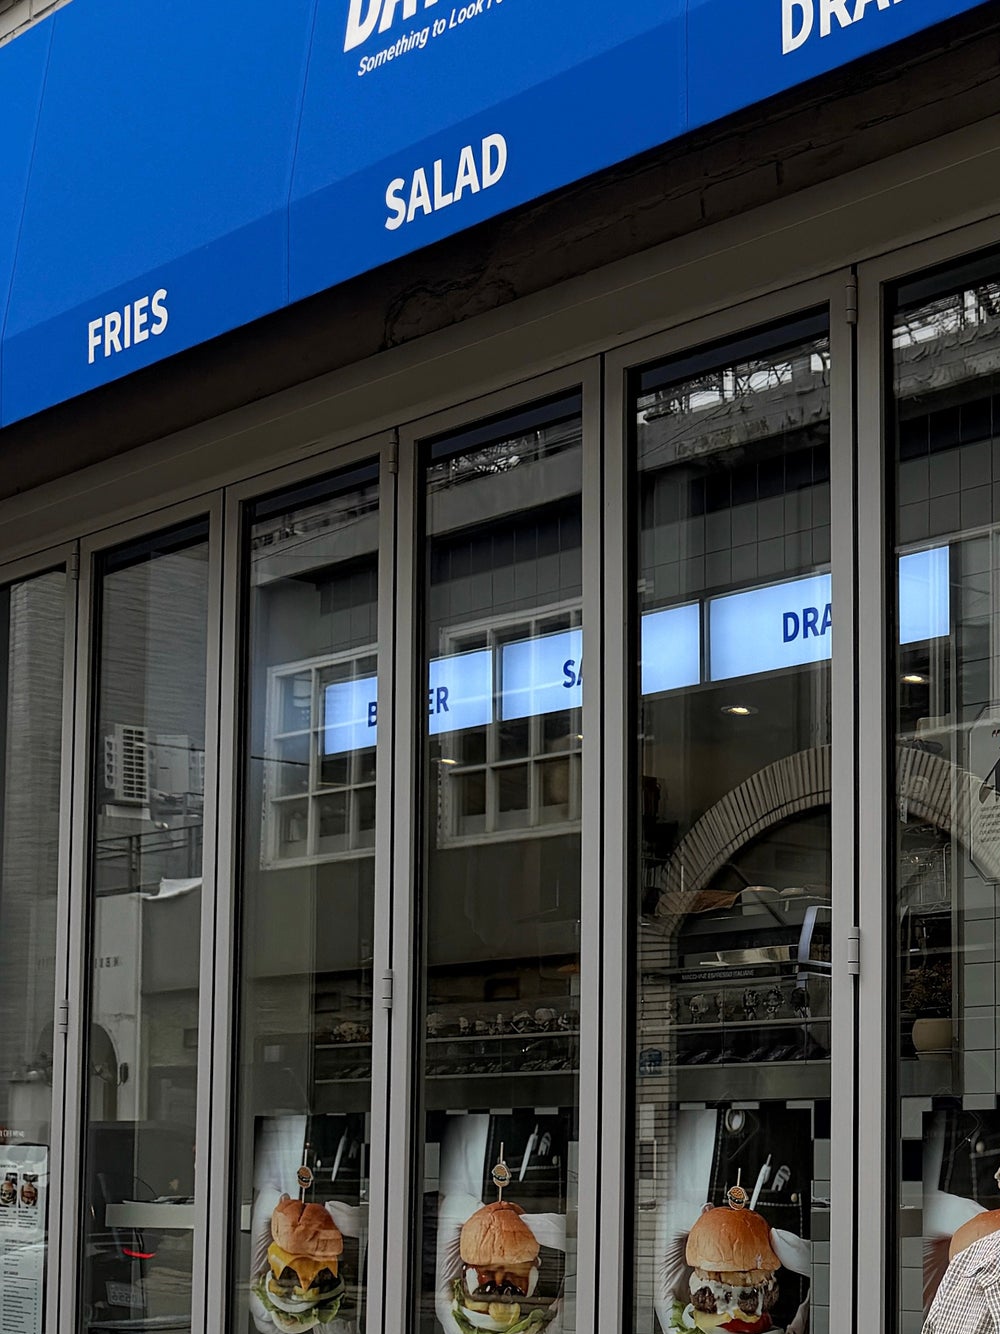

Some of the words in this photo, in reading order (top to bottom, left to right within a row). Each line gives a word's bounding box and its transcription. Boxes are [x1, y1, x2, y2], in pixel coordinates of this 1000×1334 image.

[357, 26, 429, 77] Something
[432, 19, 447, 38] to
[448, 0, 484, 29] Look
[385, 133, 507, 231] SALAD
[87, 287, 169, 364] FRIES
